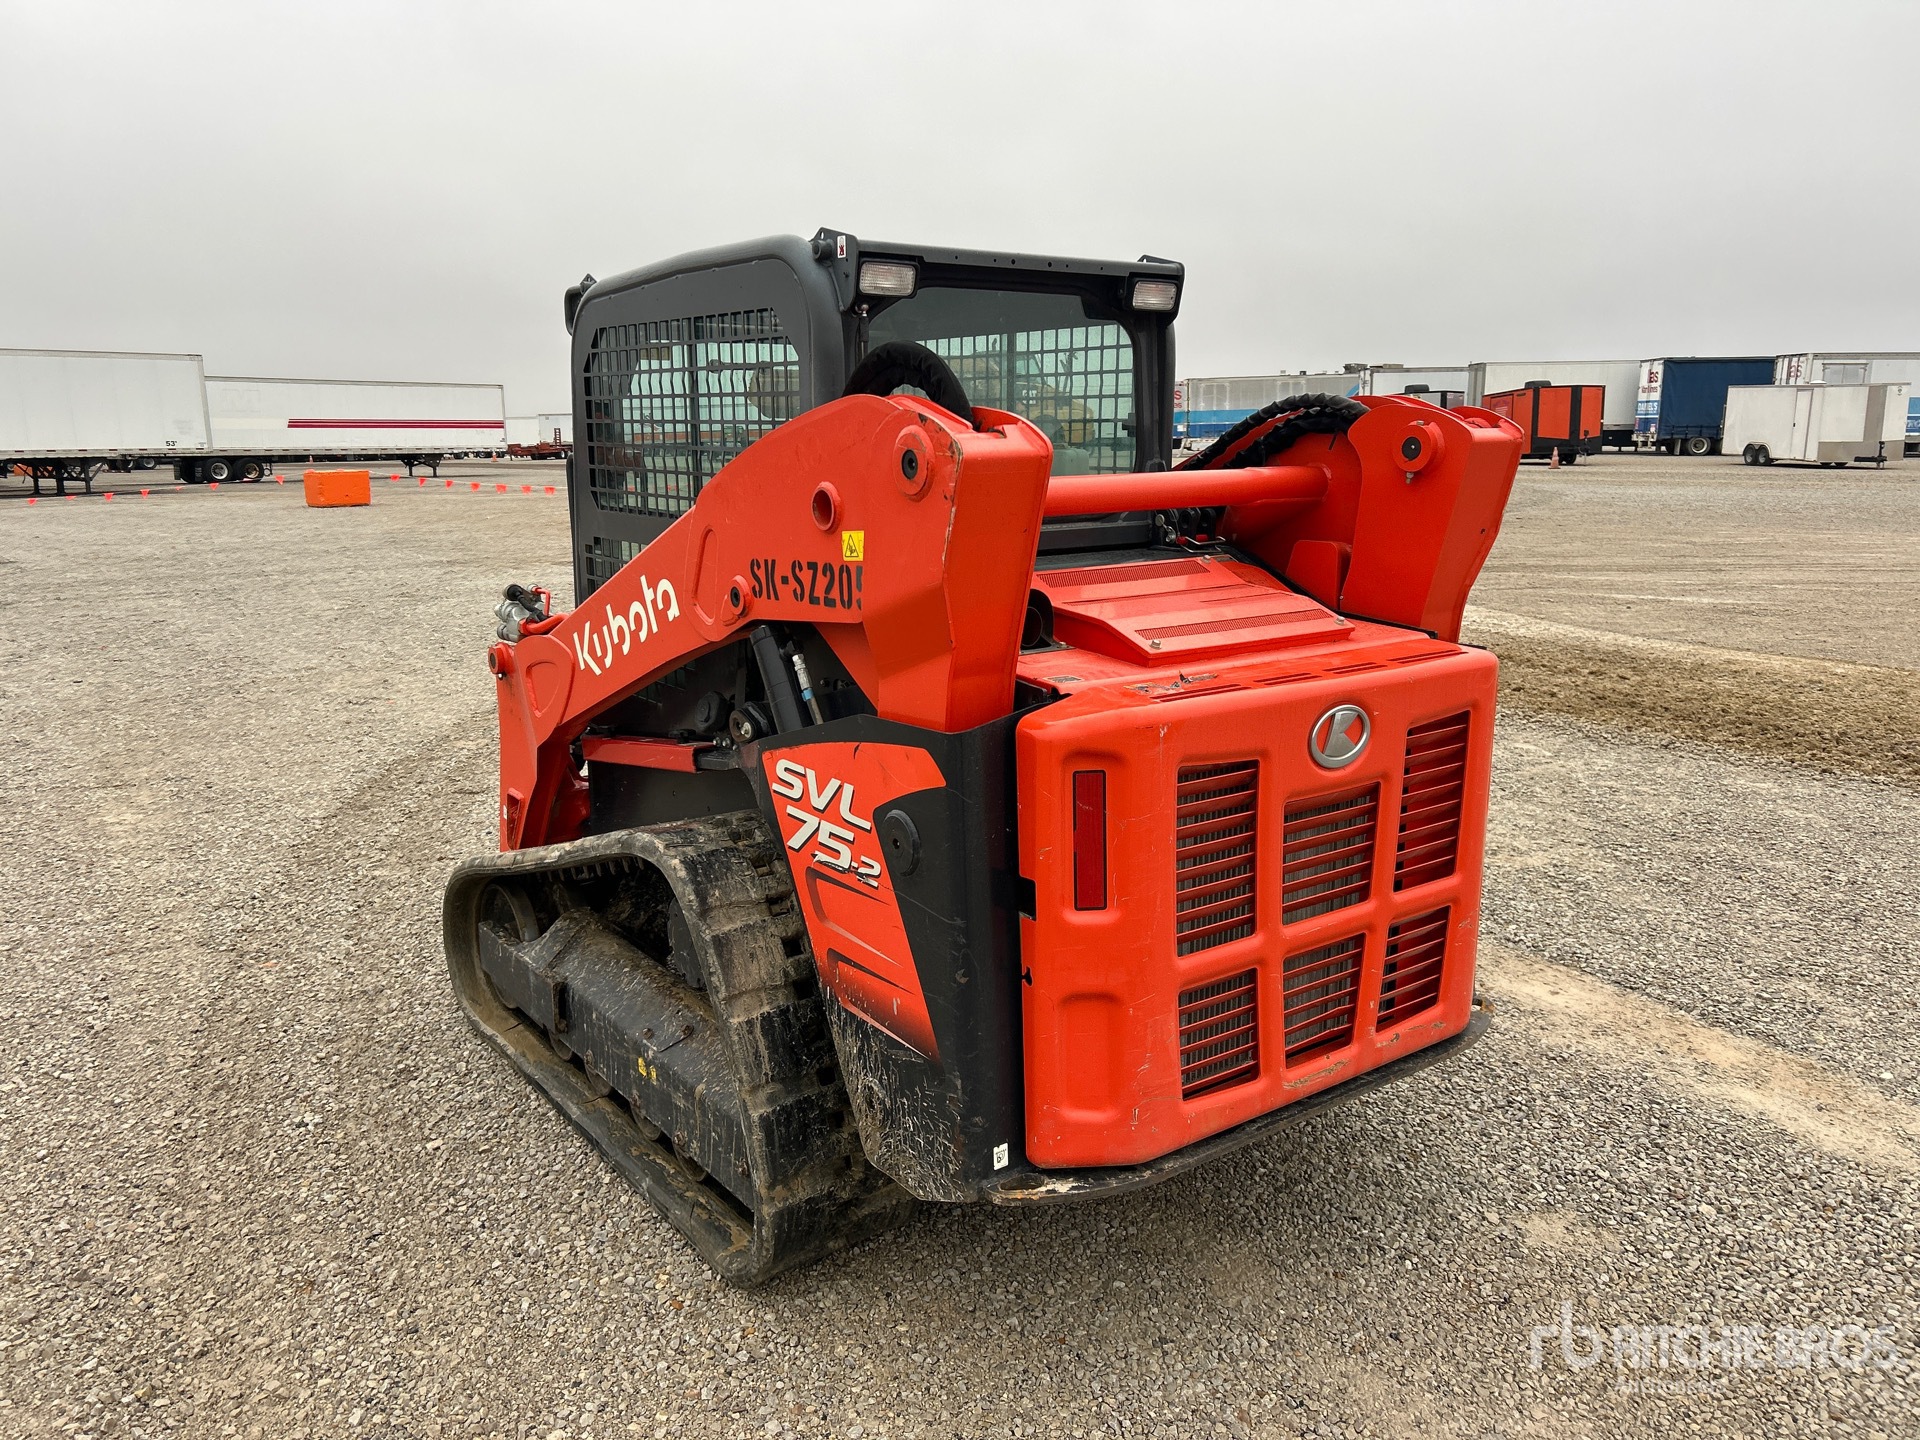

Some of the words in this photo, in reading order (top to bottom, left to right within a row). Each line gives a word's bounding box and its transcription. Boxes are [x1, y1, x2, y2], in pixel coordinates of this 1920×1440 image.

[573, 574, 681, 676] Kubota
[771, 758, 872, 834] SVL
[785, 804, 881, 890] 75-2
